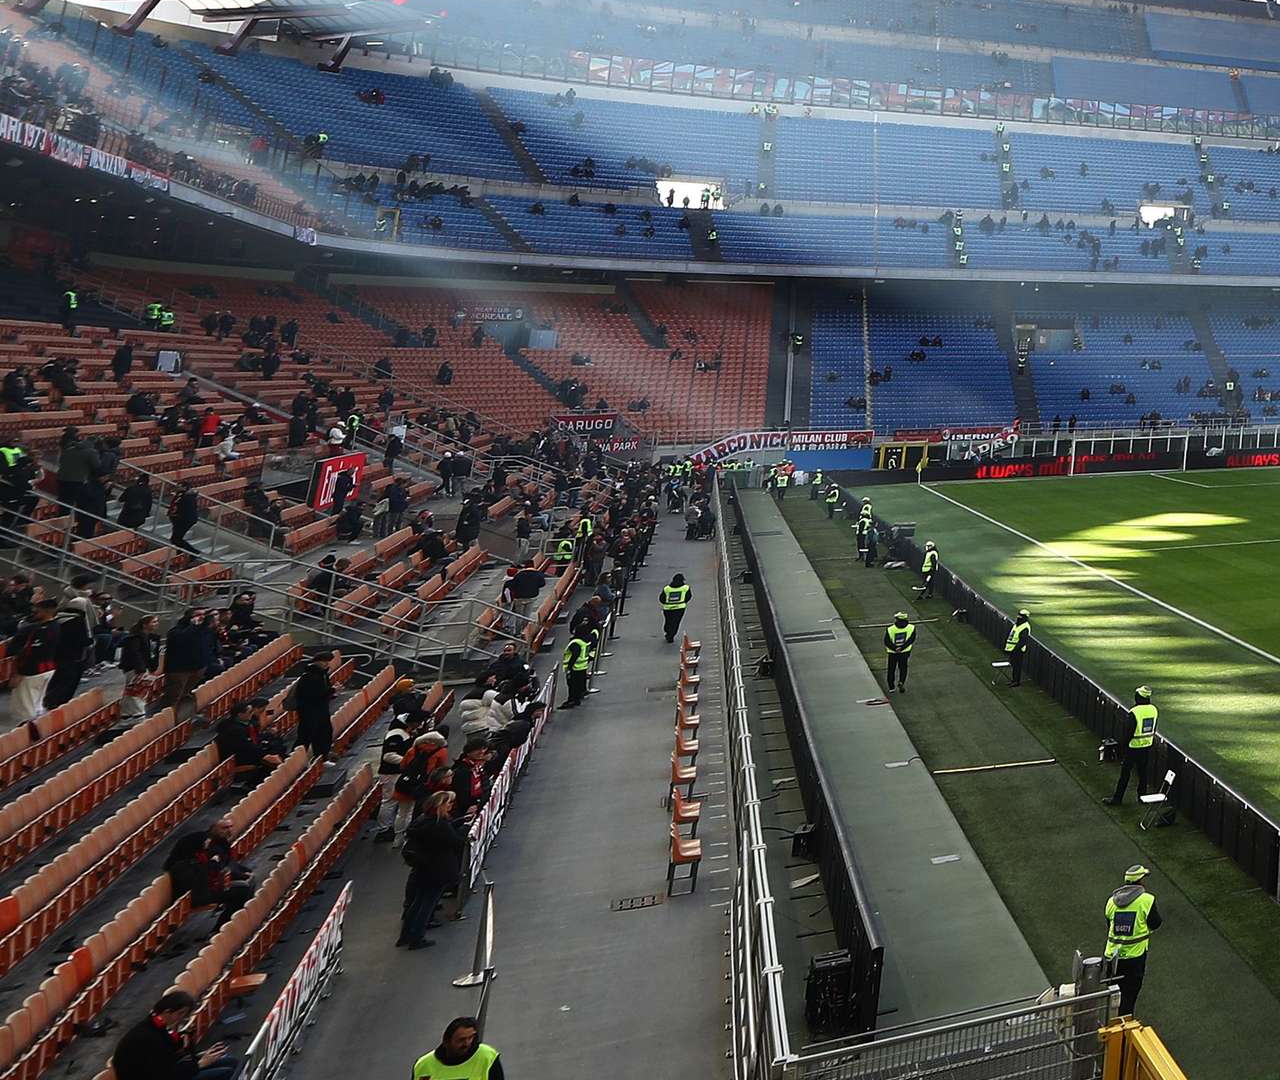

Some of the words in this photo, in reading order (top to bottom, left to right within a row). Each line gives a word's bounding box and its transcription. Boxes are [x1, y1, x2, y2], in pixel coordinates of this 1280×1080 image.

[558, 419, 613, 431] CARUGO
[792, 434, 822, 443] MILAN
[825, 433, 848, 442] CLUB
[613, 441, 638, 451] PARK
